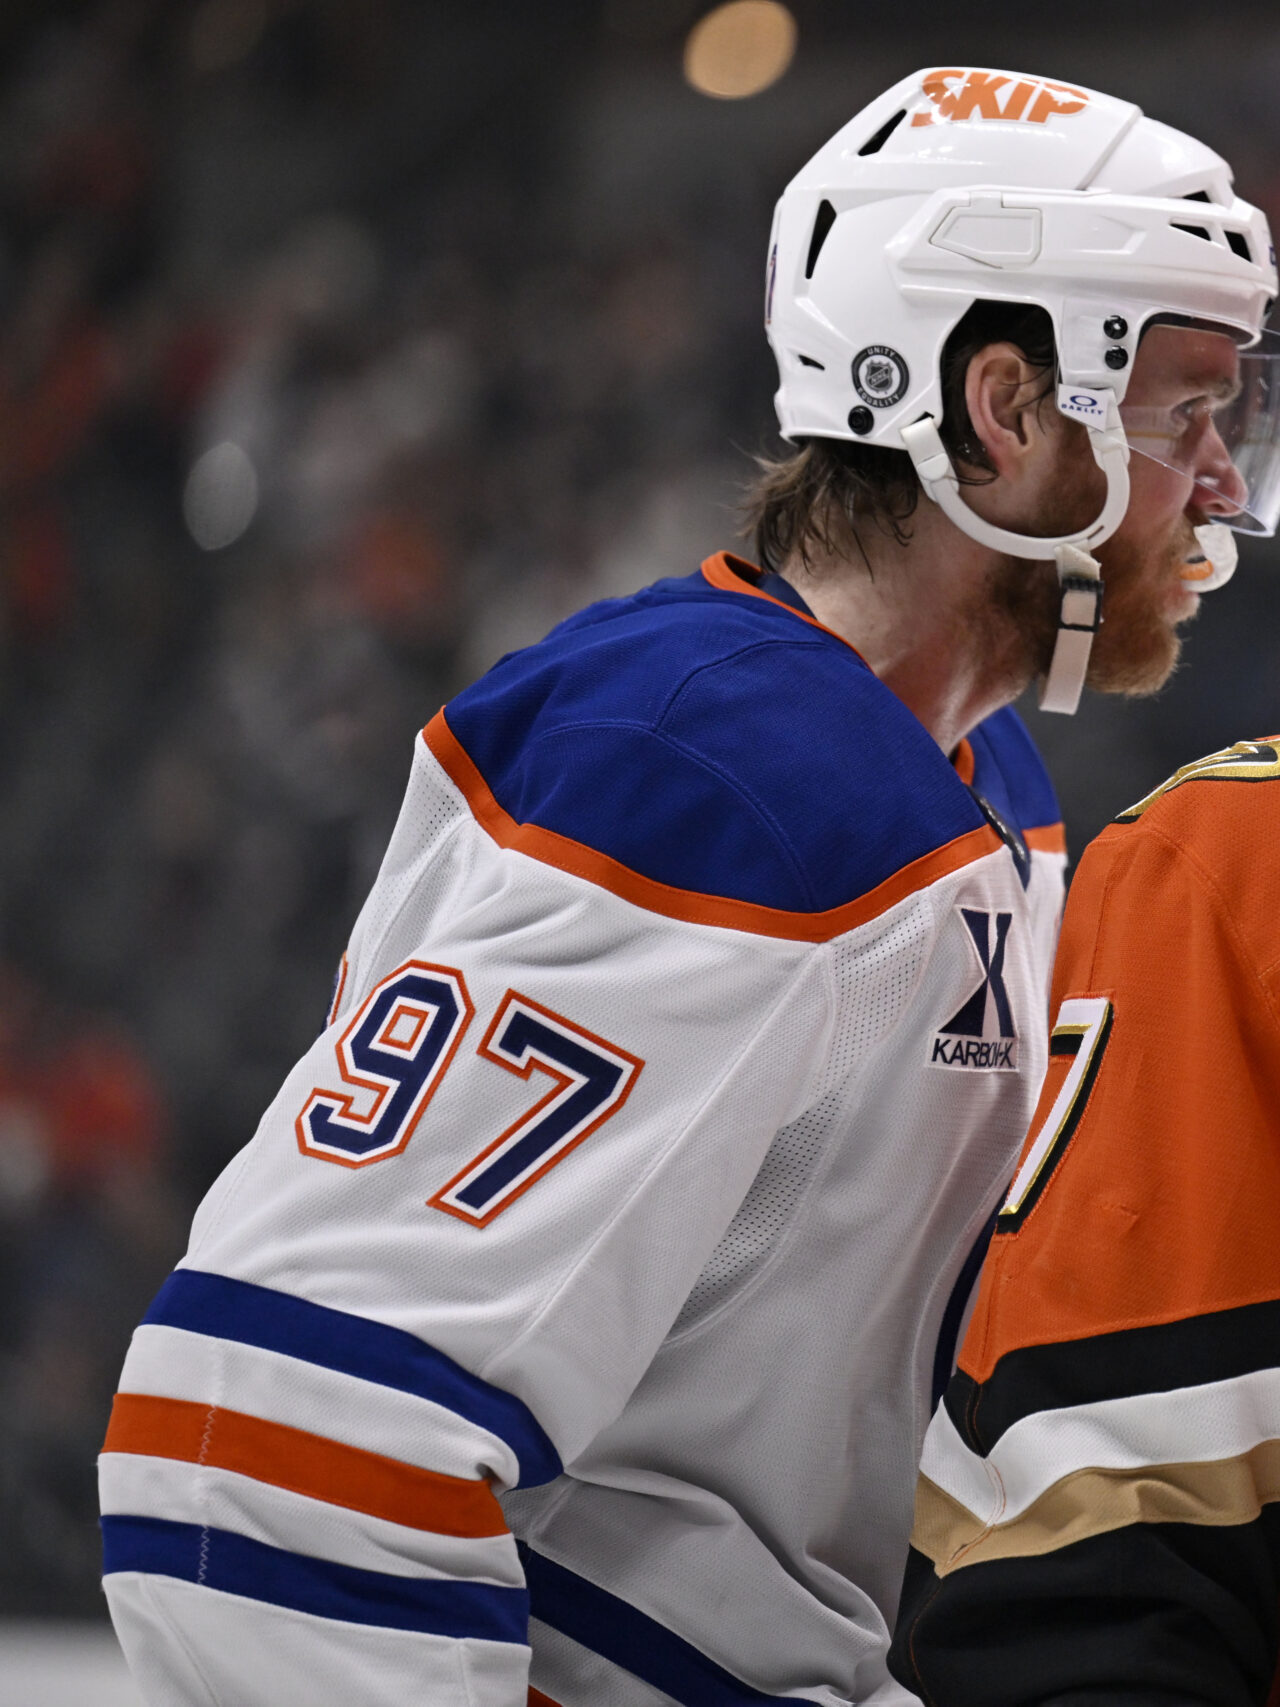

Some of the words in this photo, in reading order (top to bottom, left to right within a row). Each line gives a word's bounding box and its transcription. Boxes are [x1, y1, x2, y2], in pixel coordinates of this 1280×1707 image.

[911, 70, 1090, 127] SKIP
[867, 346, 896, 357] UNITY
[857, 386, 899, 407] EQUALITY
[1061, 403, 1104, 415] OAKLEY
[296, 960, 644, 1228] 97
[997, 996, 1113, 1235] 7
